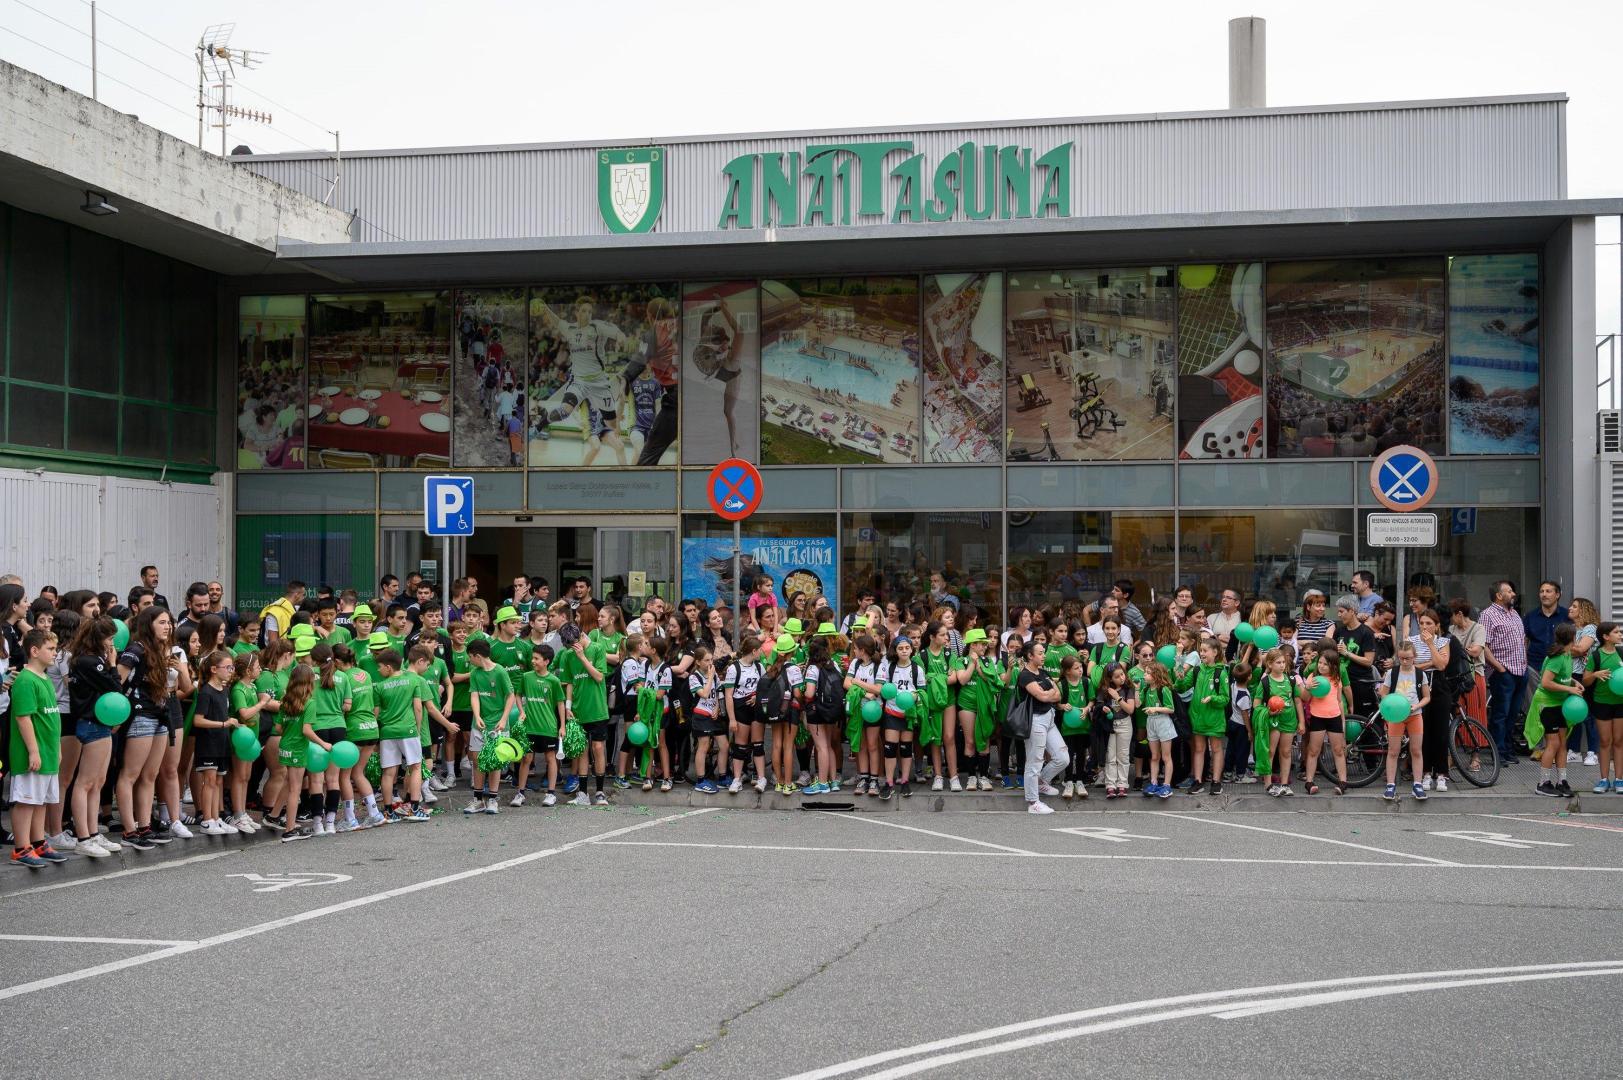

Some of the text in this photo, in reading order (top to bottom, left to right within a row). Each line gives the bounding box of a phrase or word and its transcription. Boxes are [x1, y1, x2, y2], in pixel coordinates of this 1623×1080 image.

[718, 141, 1075, 229] ANAITASUNA
[602, 397, 611, 407] 17
[437, 484, 464, 528] P
[751, 545, 833, 566] ANAITASUNA
[745, 677, 757, 688] 27
[897, 680, 909, 690] 24
